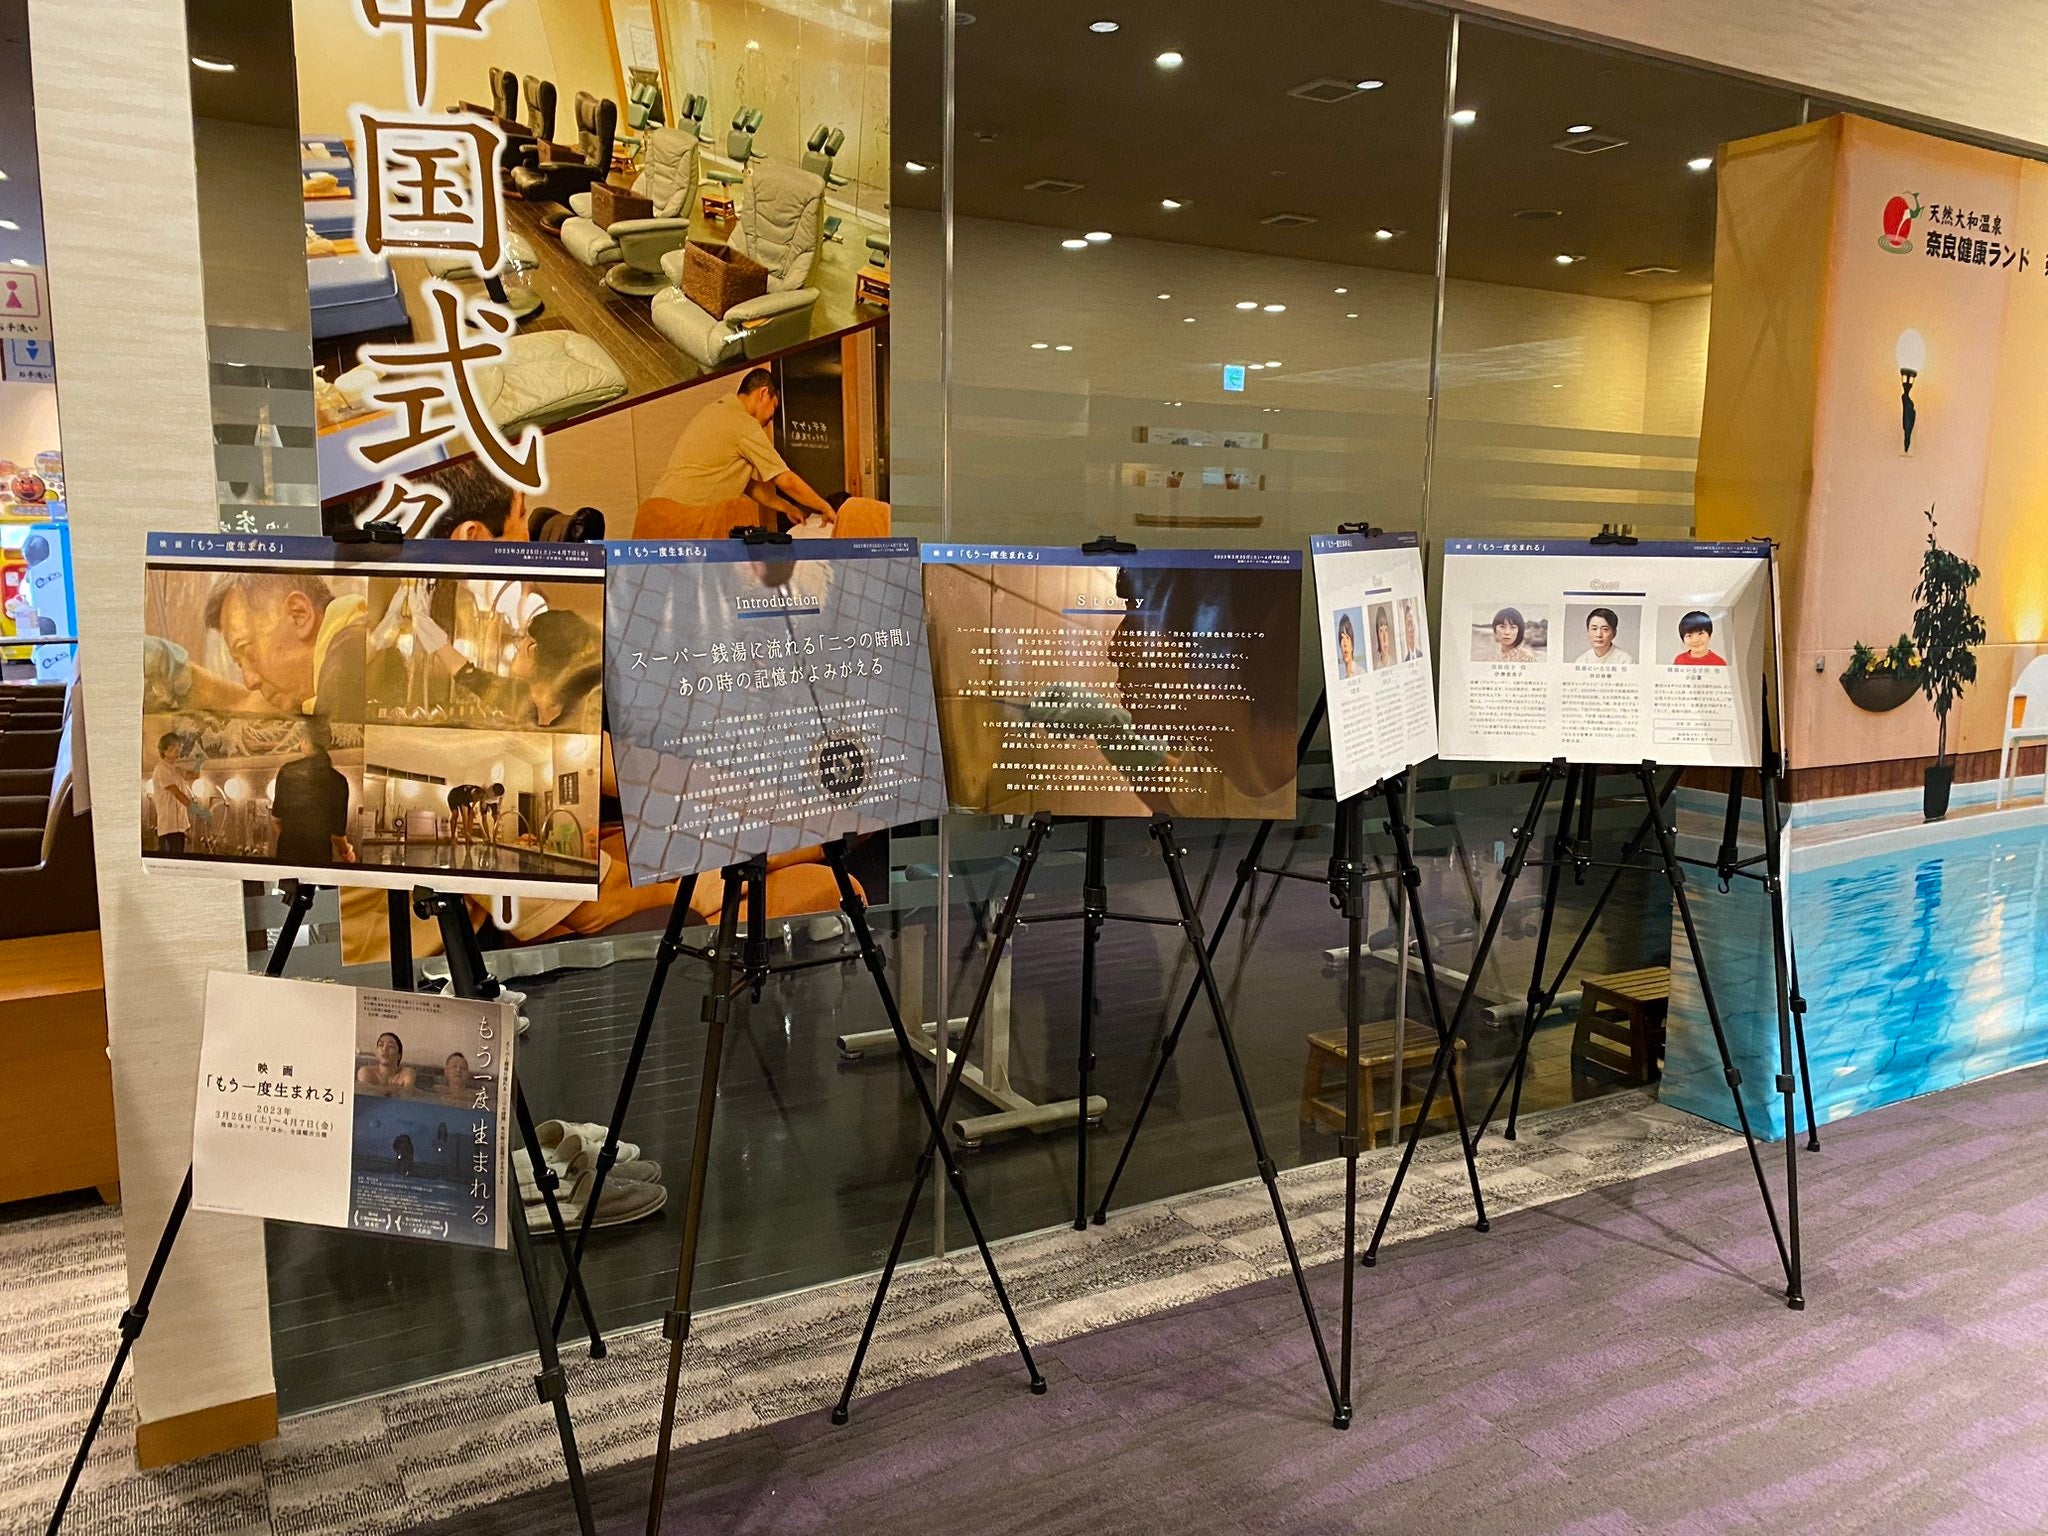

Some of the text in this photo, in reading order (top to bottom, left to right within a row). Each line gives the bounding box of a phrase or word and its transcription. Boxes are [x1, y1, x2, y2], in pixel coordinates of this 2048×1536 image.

[1929, 204, 2003, 235] 天然大和温泉
[1926, 231, 2030, 273] 奈良健康ランド
[735, 594, 820, 610] Introduction
[1077, 594, 1145, 609] Story
[630, 628, 911, 671] スーパー銭湯に流れる「二つの時間」
[679, 657, 883, 697] あの時の記憶がよみがえる
[206, 1074, 344, 1105] 「もう一度生まれる」
[256, 1105, 292, 1116] 2023年
[470, 1015, 494, 1226] もう一度生まれる
